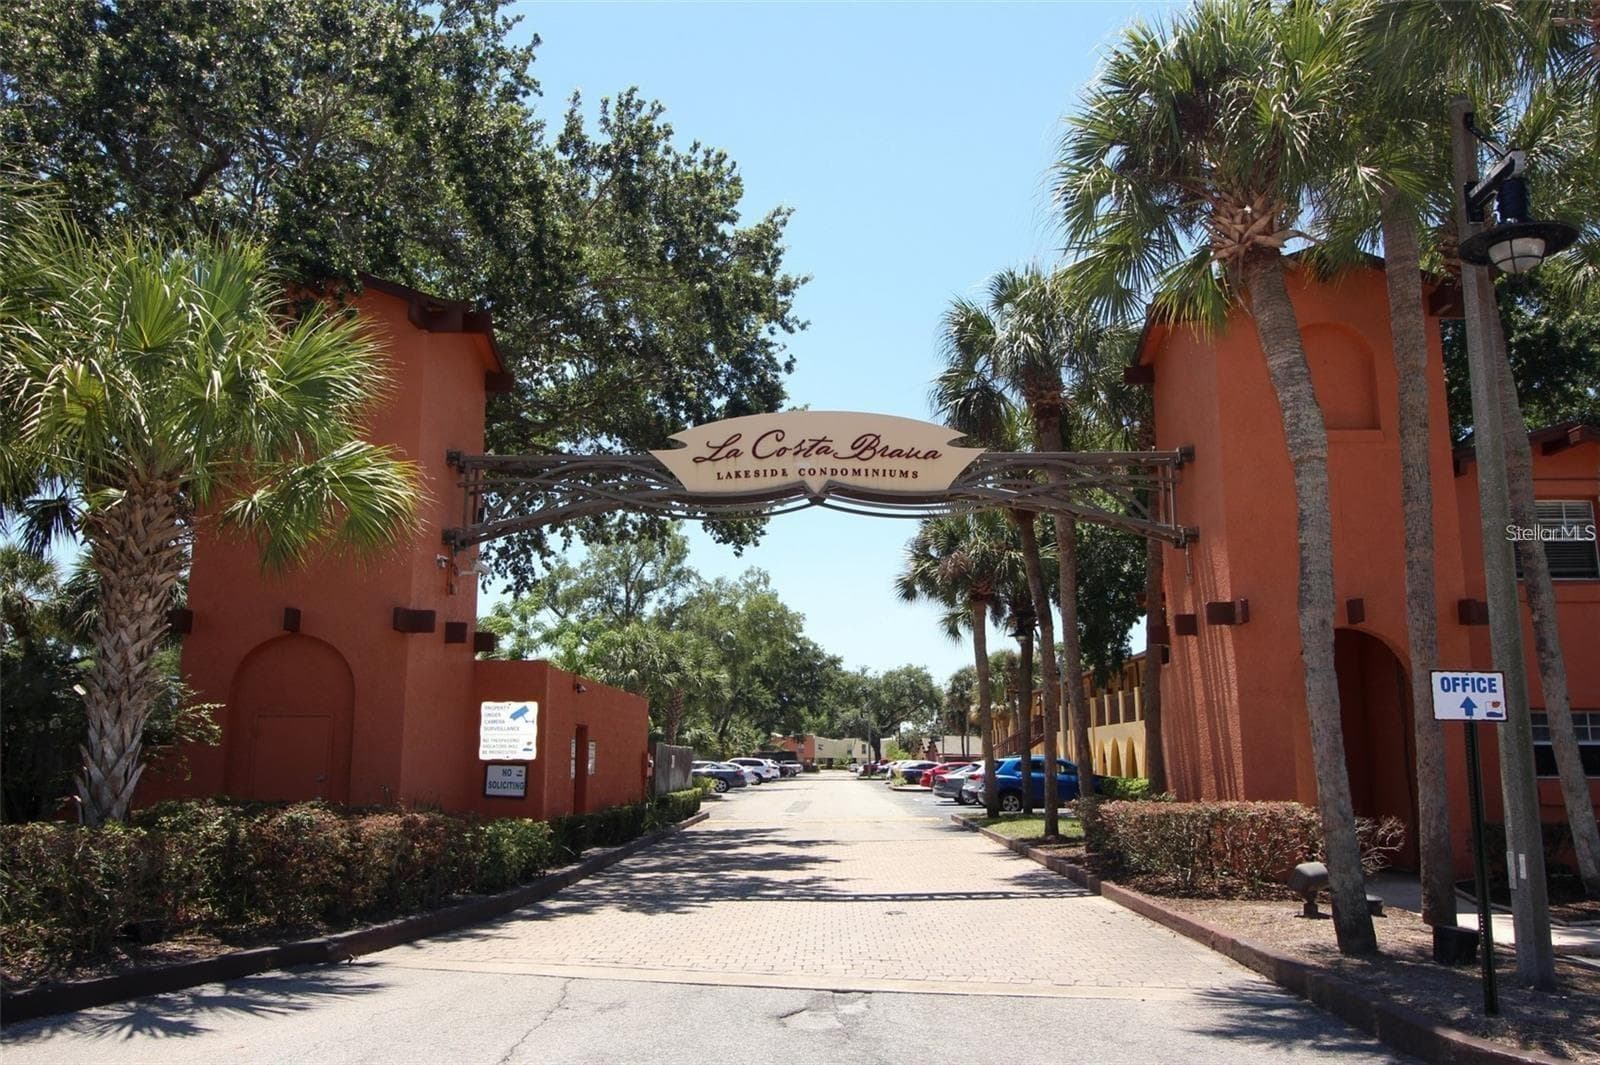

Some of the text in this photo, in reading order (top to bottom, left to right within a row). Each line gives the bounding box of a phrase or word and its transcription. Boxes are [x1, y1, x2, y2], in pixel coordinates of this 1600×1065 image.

[692, 429, 943, 464] La Costa Brava
[716, 467, 920, 480] LAKESIDE CONDOMINIUMS
[1440, 676, 1497, 693] OFFICE
[502, 768, 512, 777] NO
[488, 780, 524, 790] SOLICITING
